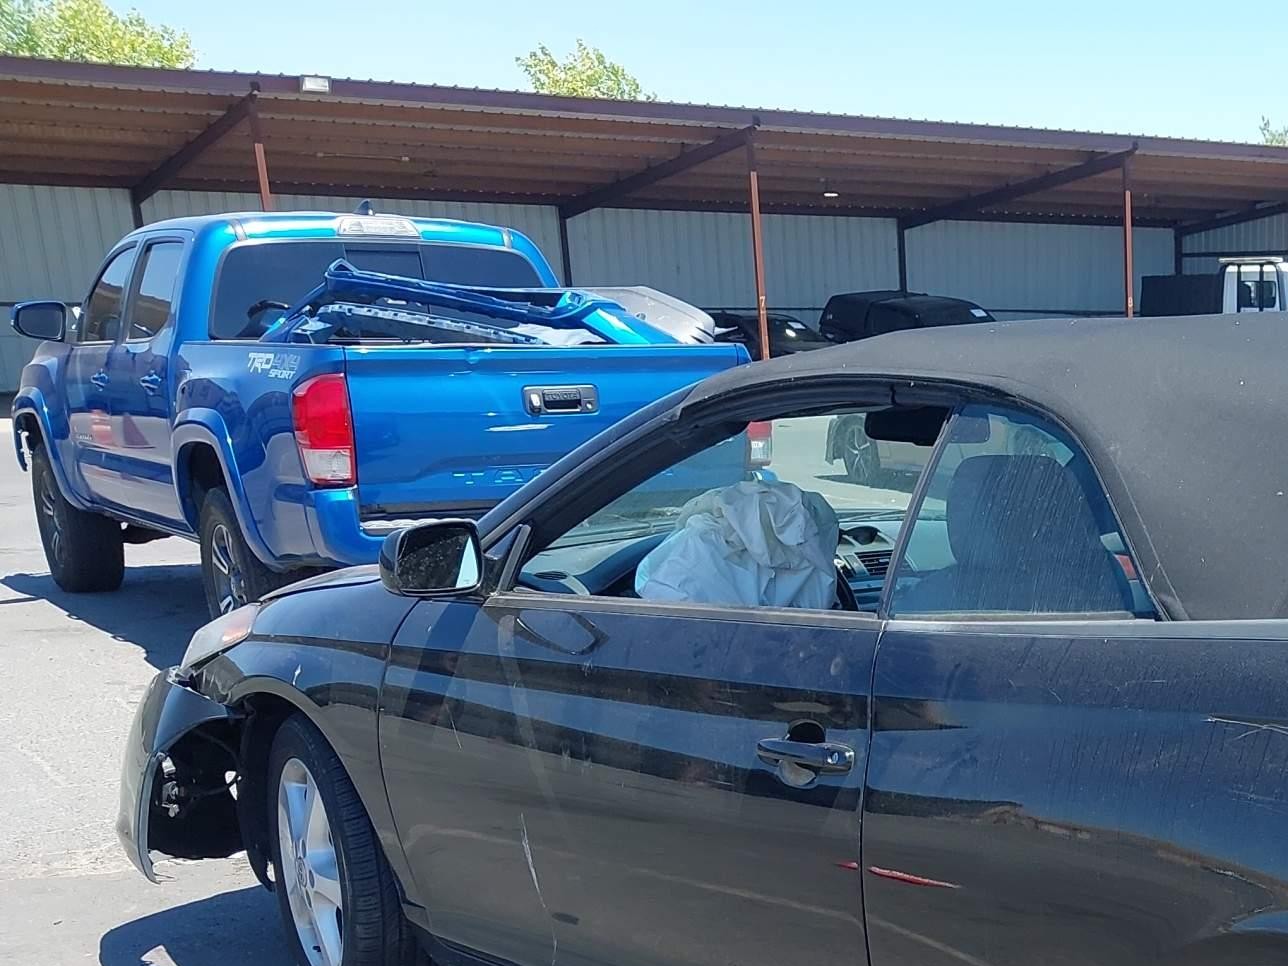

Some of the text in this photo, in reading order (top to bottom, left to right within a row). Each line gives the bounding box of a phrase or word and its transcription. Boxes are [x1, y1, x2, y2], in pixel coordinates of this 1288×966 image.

[248, 352, 275, 373] TRD
[267, 369, 296, 380] SPORT
[545, 392, 578, 400] TOYOTA
